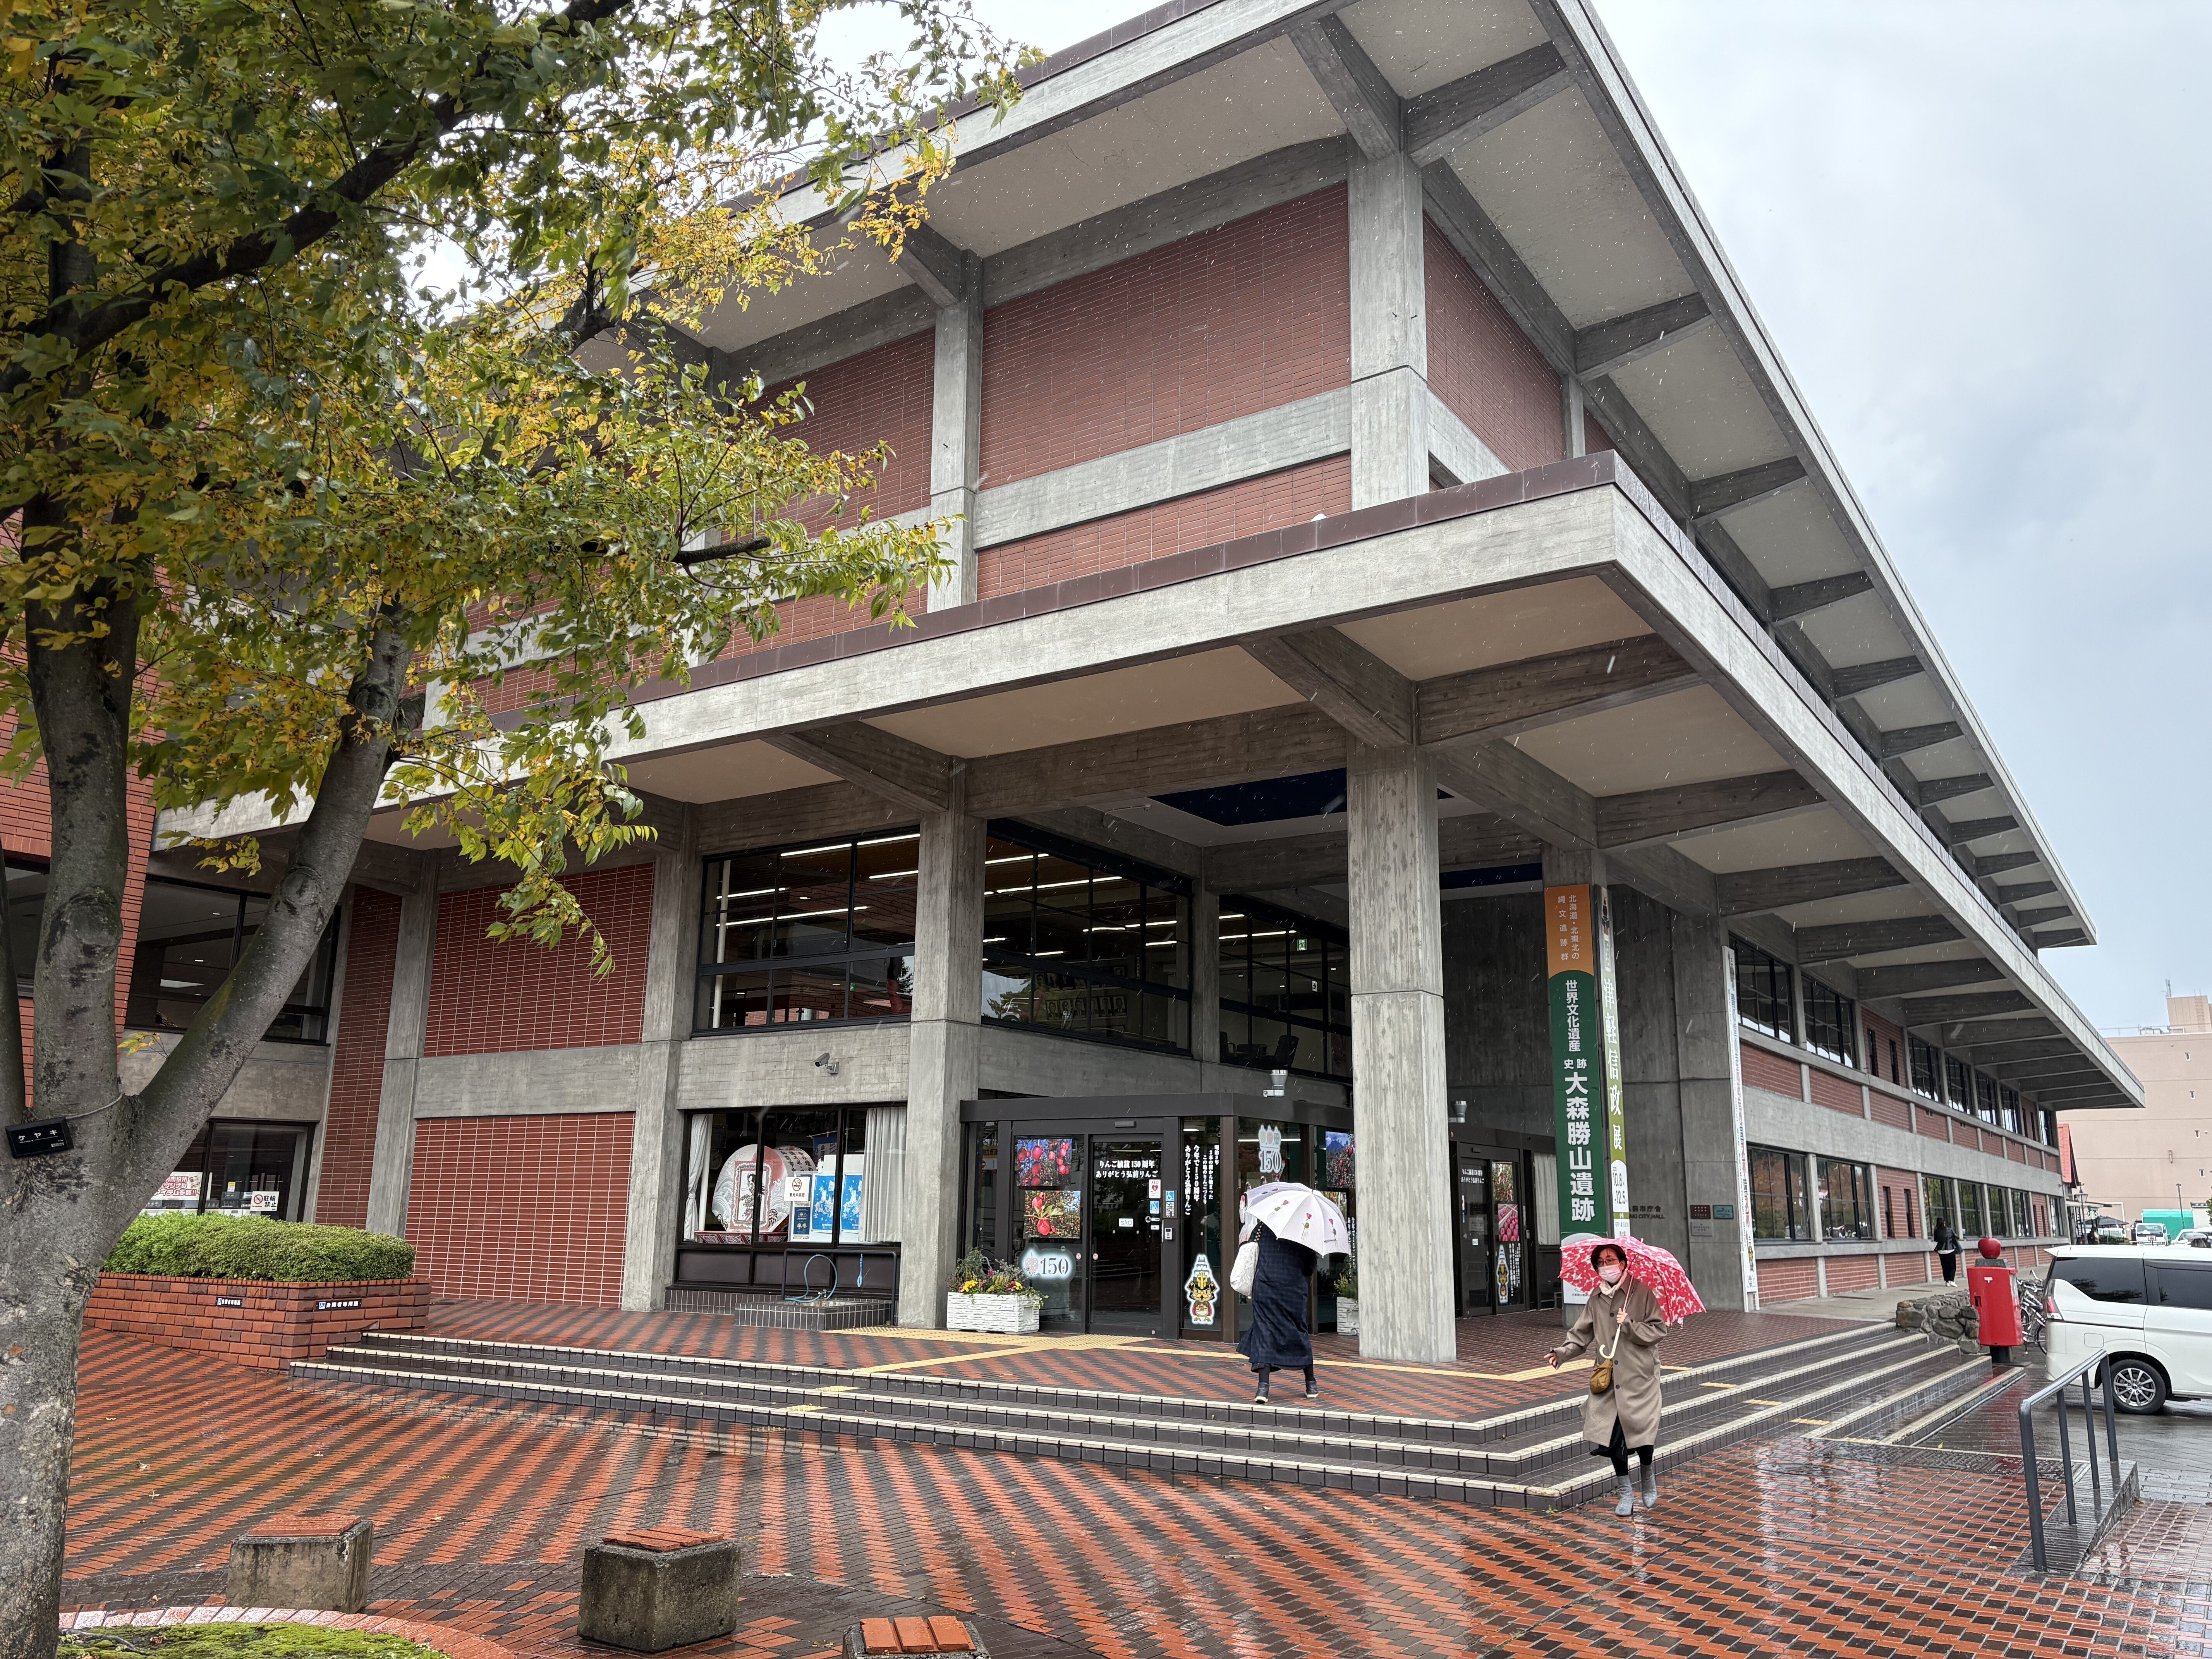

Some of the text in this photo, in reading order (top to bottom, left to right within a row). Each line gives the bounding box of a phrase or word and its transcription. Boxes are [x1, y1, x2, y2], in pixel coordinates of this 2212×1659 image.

[1558, 896, 1568, 961] 縄文遺跡群
[1569, 895, 1579, 960] 北海道・北東北の
[1565, 980, 1581, 1052] 世界文化遺産
[1564, 1059, 1587, 1069] 史跡
[1603, 978, 1622, 1150] 津軽信政展
[18, 1129, 57, 1141] ケヤキ
[1259, 1151, 1280, 1170] 150
[1565, 1072, 1595, 1222] 大森勝山遺跡
[1040, 1257, 1069, 1275] 150
